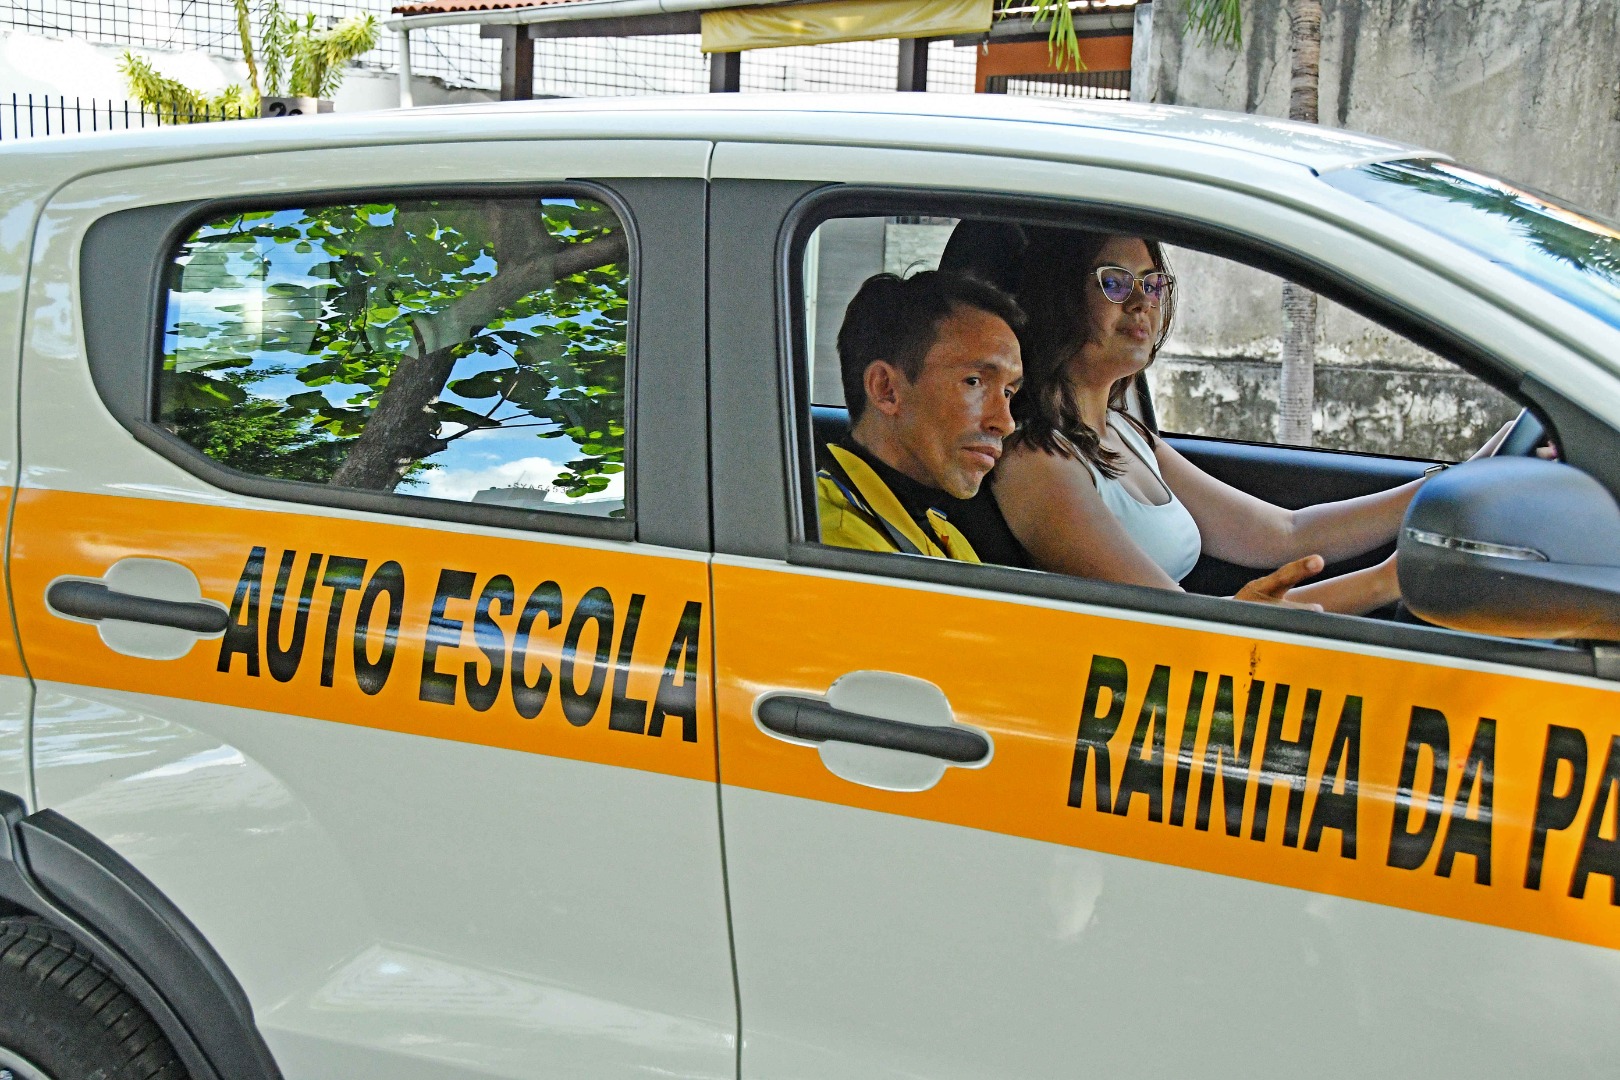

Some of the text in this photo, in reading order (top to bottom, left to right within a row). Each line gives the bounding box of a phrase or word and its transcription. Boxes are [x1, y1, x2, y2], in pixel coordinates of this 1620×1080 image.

[268, 102, 303, 118] 2
[217, 546, 702, 743] AUTO ESCOLA
[1067, 654, 1363, 860] RAINHA
[1387, 705, 1497, 886] DA
